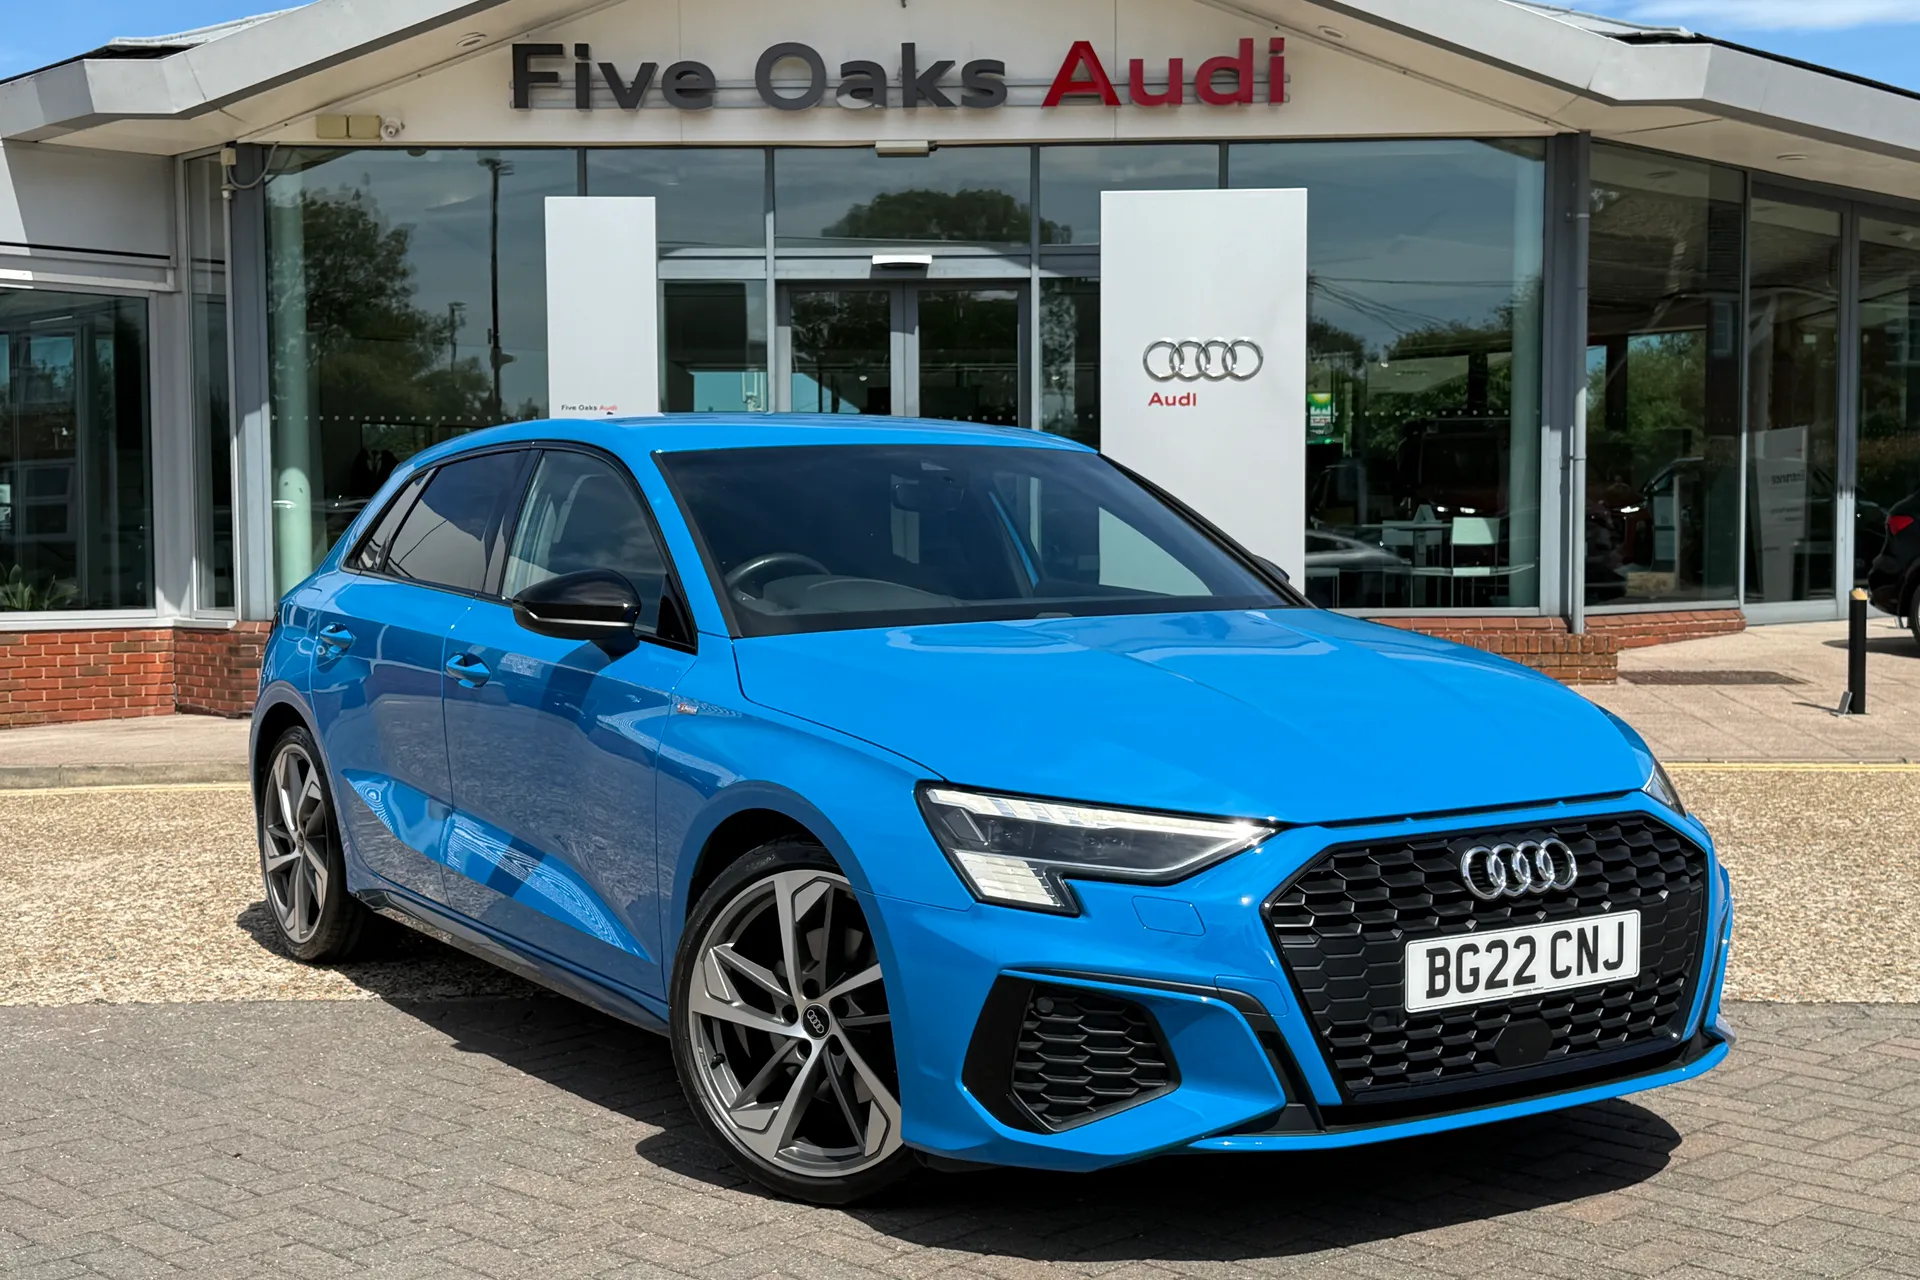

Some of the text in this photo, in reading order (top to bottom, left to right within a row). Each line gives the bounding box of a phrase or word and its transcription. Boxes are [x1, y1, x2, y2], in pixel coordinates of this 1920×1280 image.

[512, 38, 1285, 110] Five Oaks Audi
[1148, 392, 1197, 406] Audi
[1426, 921, 1624, 999] BG22 CNJ
